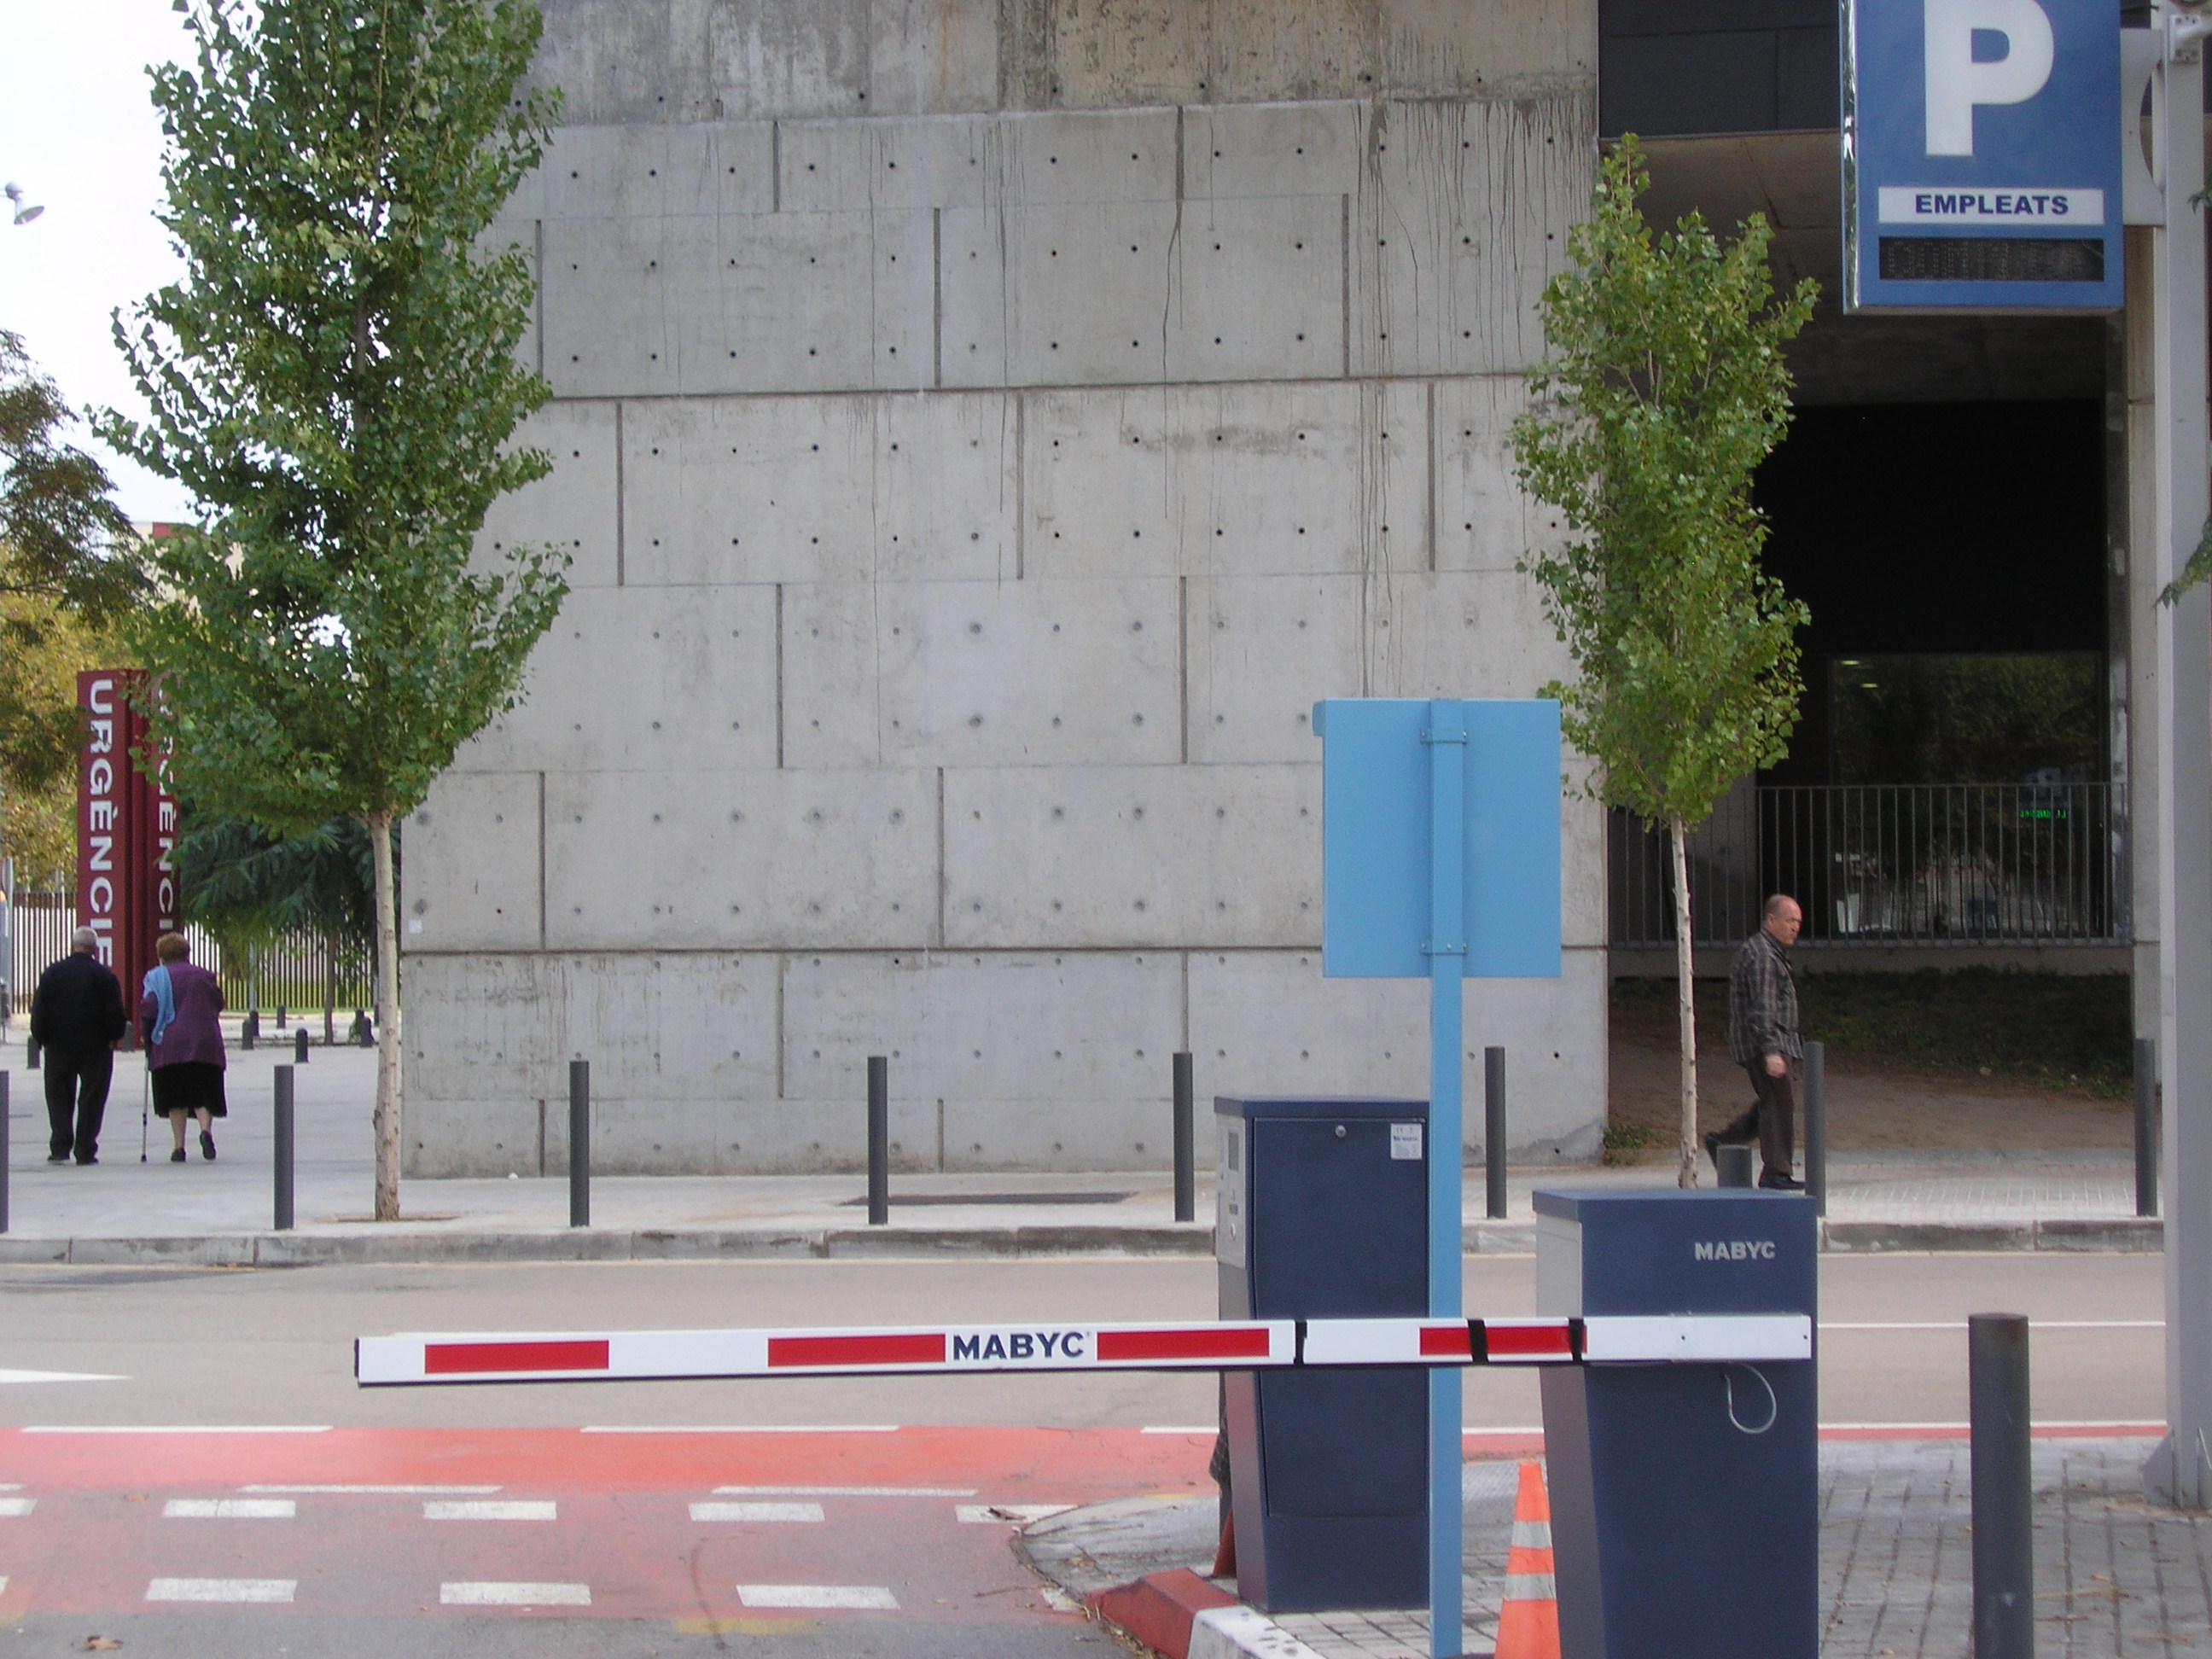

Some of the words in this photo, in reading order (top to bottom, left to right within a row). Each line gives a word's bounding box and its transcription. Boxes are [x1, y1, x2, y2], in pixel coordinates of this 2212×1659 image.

[1924, 0, 2055, 156] P
[1915, 194, 2069, 215] EMPLEATS
[1695, 1241, 1776, 1260] MABYC
[953, 1331, 1084, 1360] MABYC
